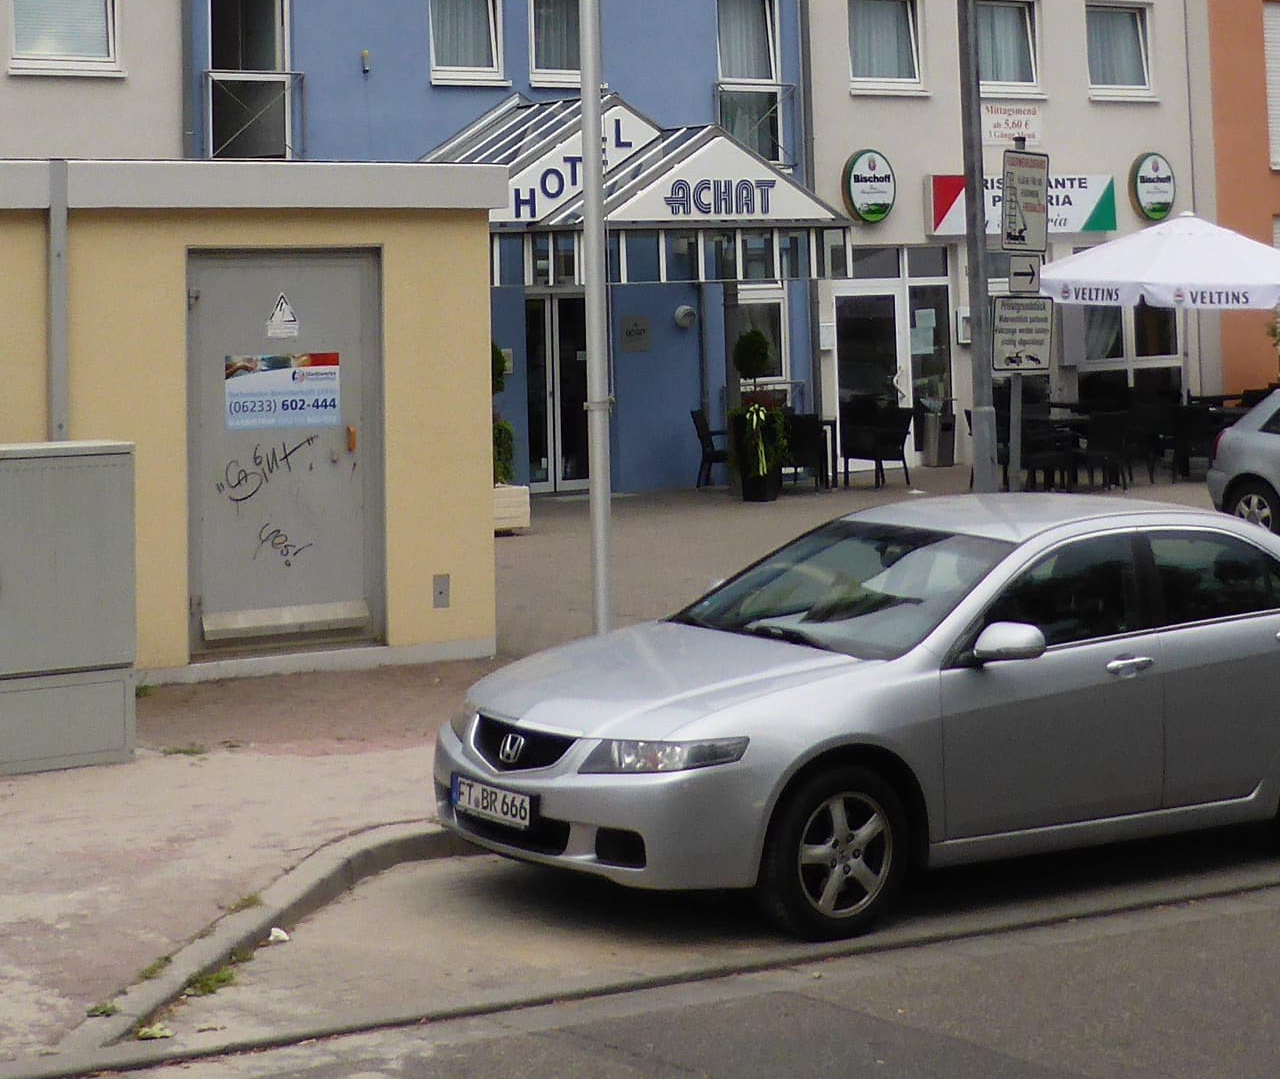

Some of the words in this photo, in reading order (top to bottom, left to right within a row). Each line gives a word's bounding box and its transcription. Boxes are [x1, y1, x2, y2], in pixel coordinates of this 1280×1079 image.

[514, 118, 633, 218] HOTL
[853, 173, 891, 183] Bischoff
[1139, 174, 1171, 184] Bischoff
[664, 179, 776, 215] ACHAT
[1073, 287, 1120, 302] VELTINS
[1190, 290, 1250, 305] VELTINS
[229, 399, 277, 415] (06233)
[281, 397, 337, 411] 602-444
[459, 781, 474, 805] FT
[481, 787, 497, 813] BR
[501, 794, 527, 821] 666
